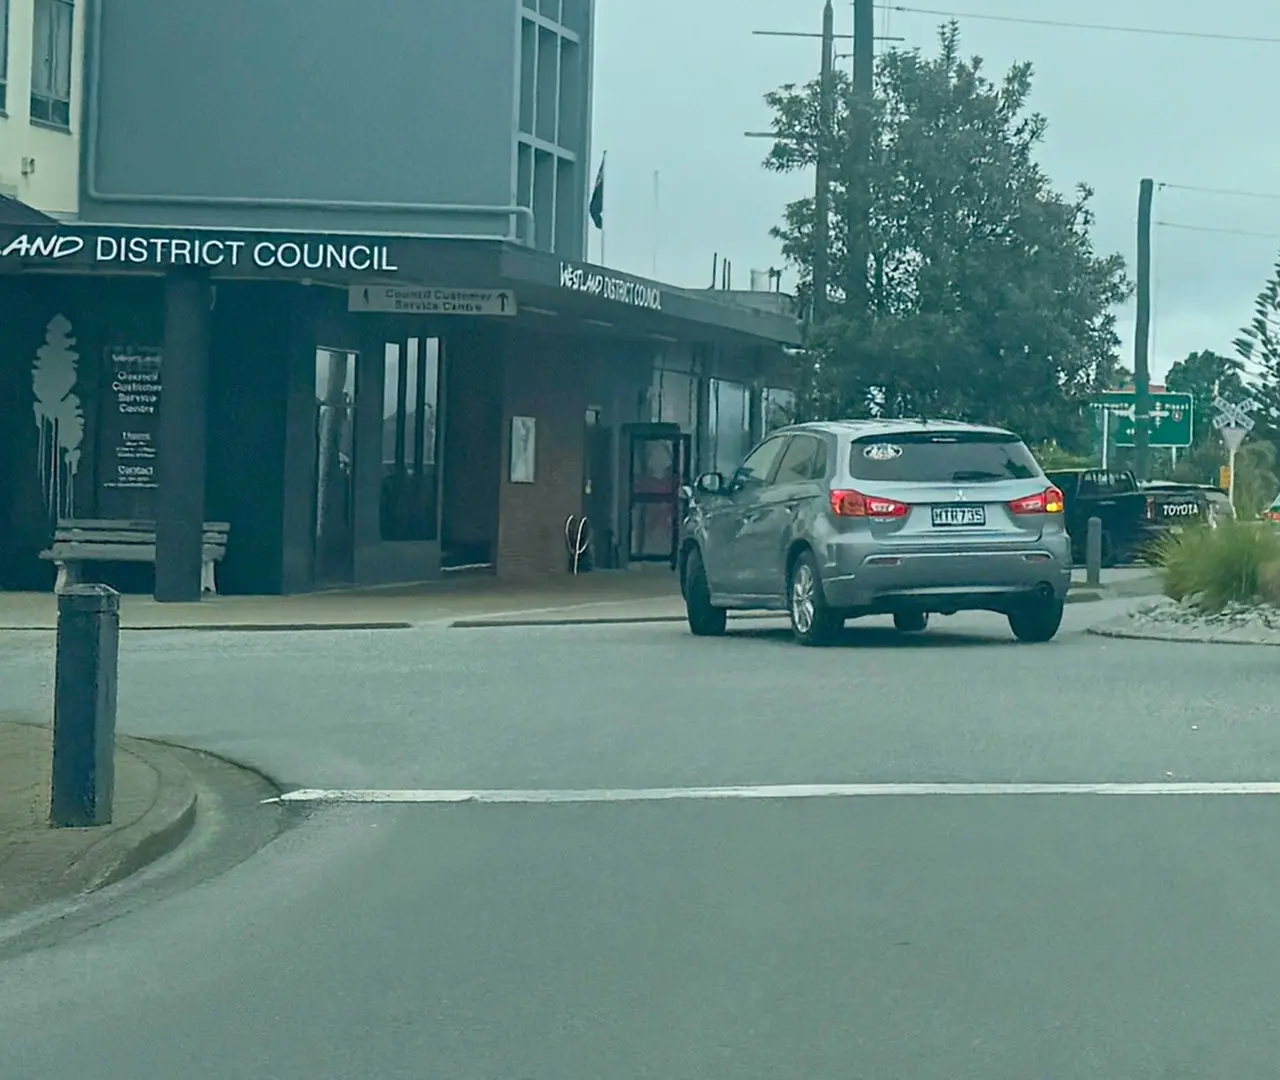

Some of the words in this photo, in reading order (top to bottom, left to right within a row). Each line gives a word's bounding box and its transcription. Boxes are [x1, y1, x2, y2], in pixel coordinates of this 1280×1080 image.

[0, 234, 84, 259] AND
[96, 236, 245, 266] DISTRICT
[253, 242, 399, 272] COUNCIL
[1163, 504, 1199, 517] TOYOTA
